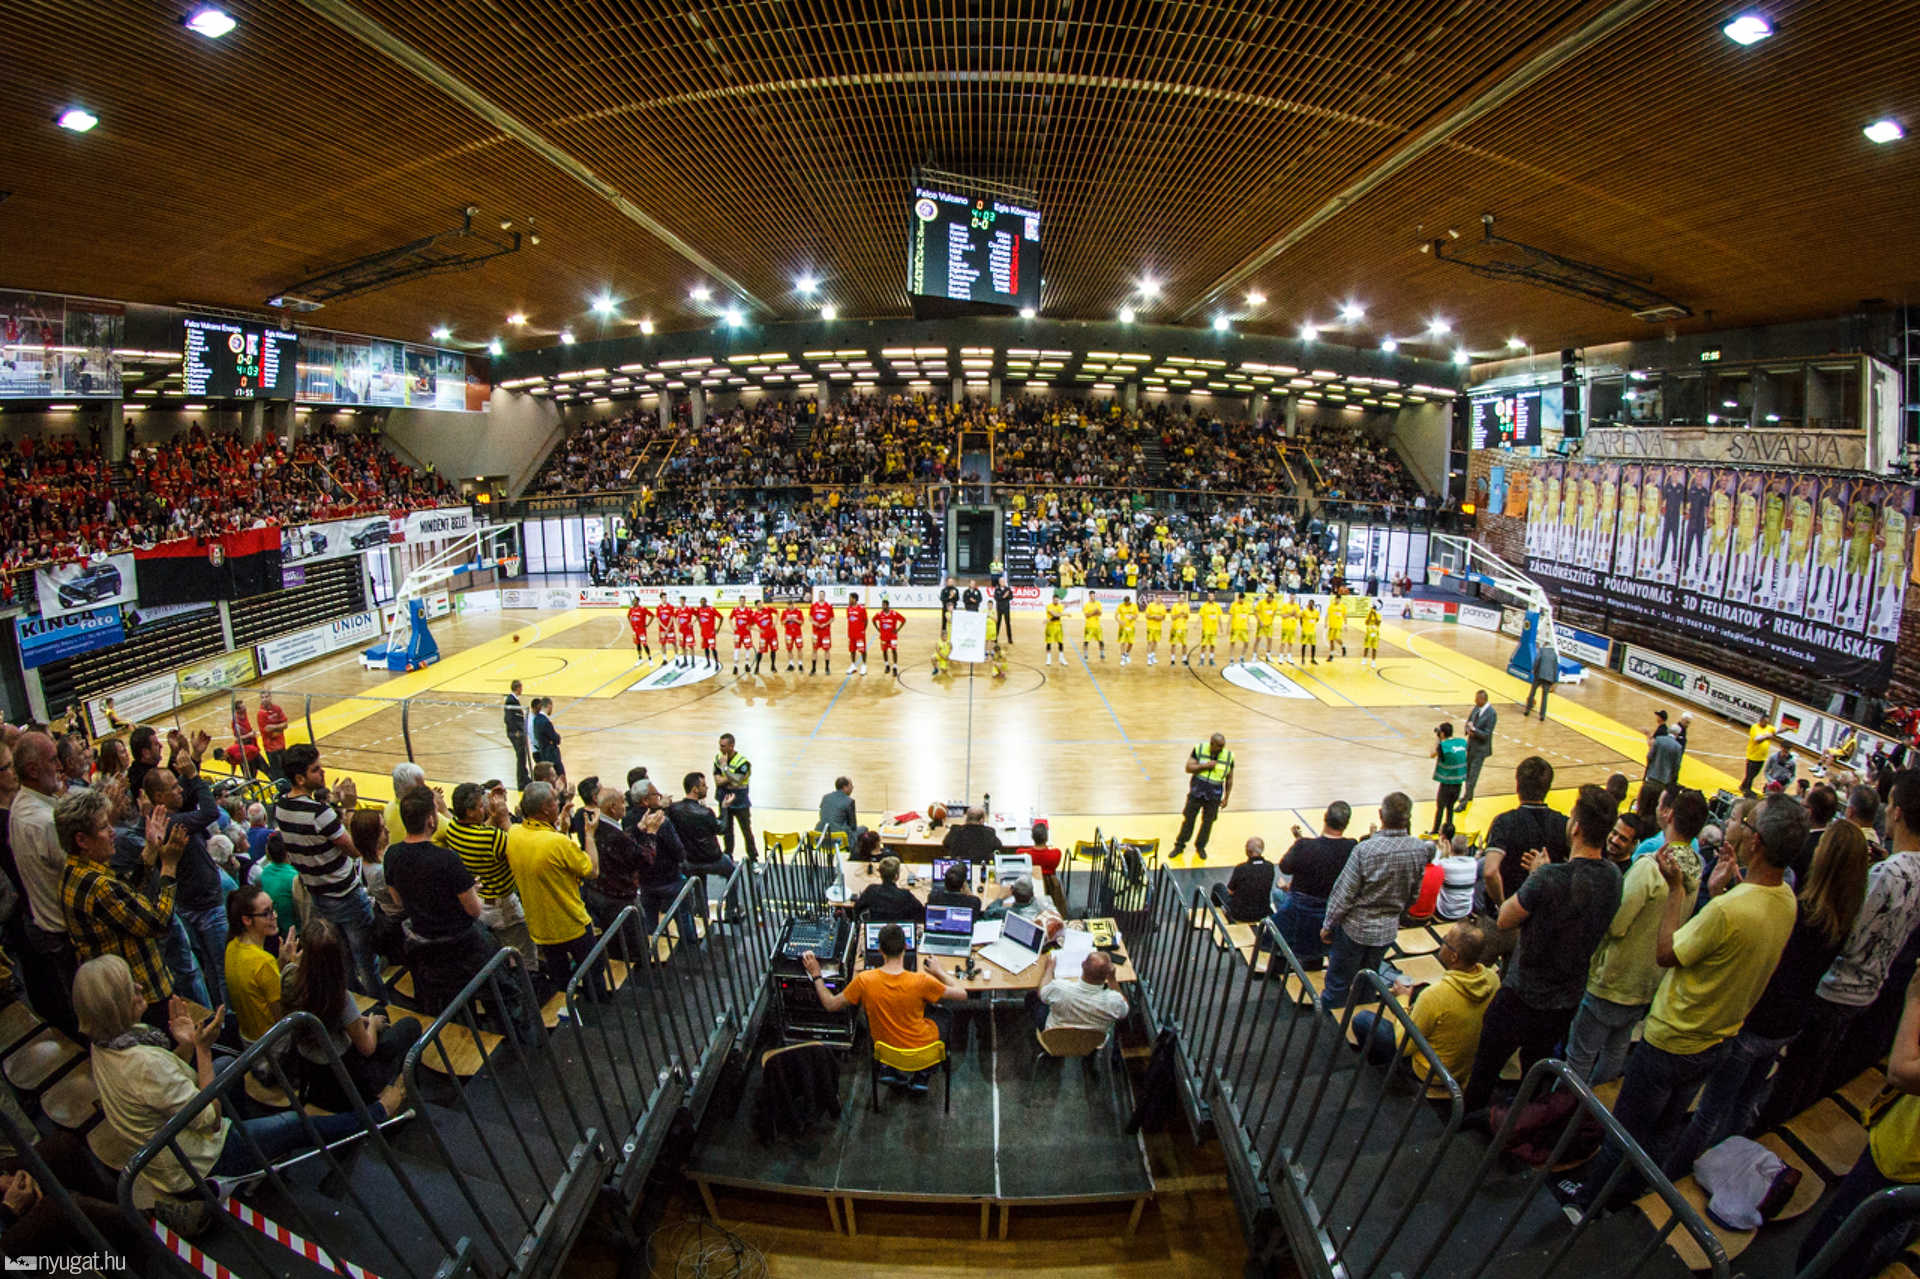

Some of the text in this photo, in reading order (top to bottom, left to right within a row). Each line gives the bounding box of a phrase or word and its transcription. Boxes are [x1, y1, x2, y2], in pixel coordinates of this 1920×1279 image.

[971, 209, 996, 222] 4:03
[236, 365, 259, 377] 4:03
[1597, 431, 1843, 465] ARENA SAVARIA
[1463, 607, 1496, 620] pannon
[1603, 574, 1673, 605] PÓLÓNYOMÁS
[1682, 594, 1697, 611] 3D
[1700, 595, 1763, 629] FELIRATOK
[1773, 617, 1884, 662] REKLÁMTÁSKÁK
[332, 613, 372, 634] UNION
